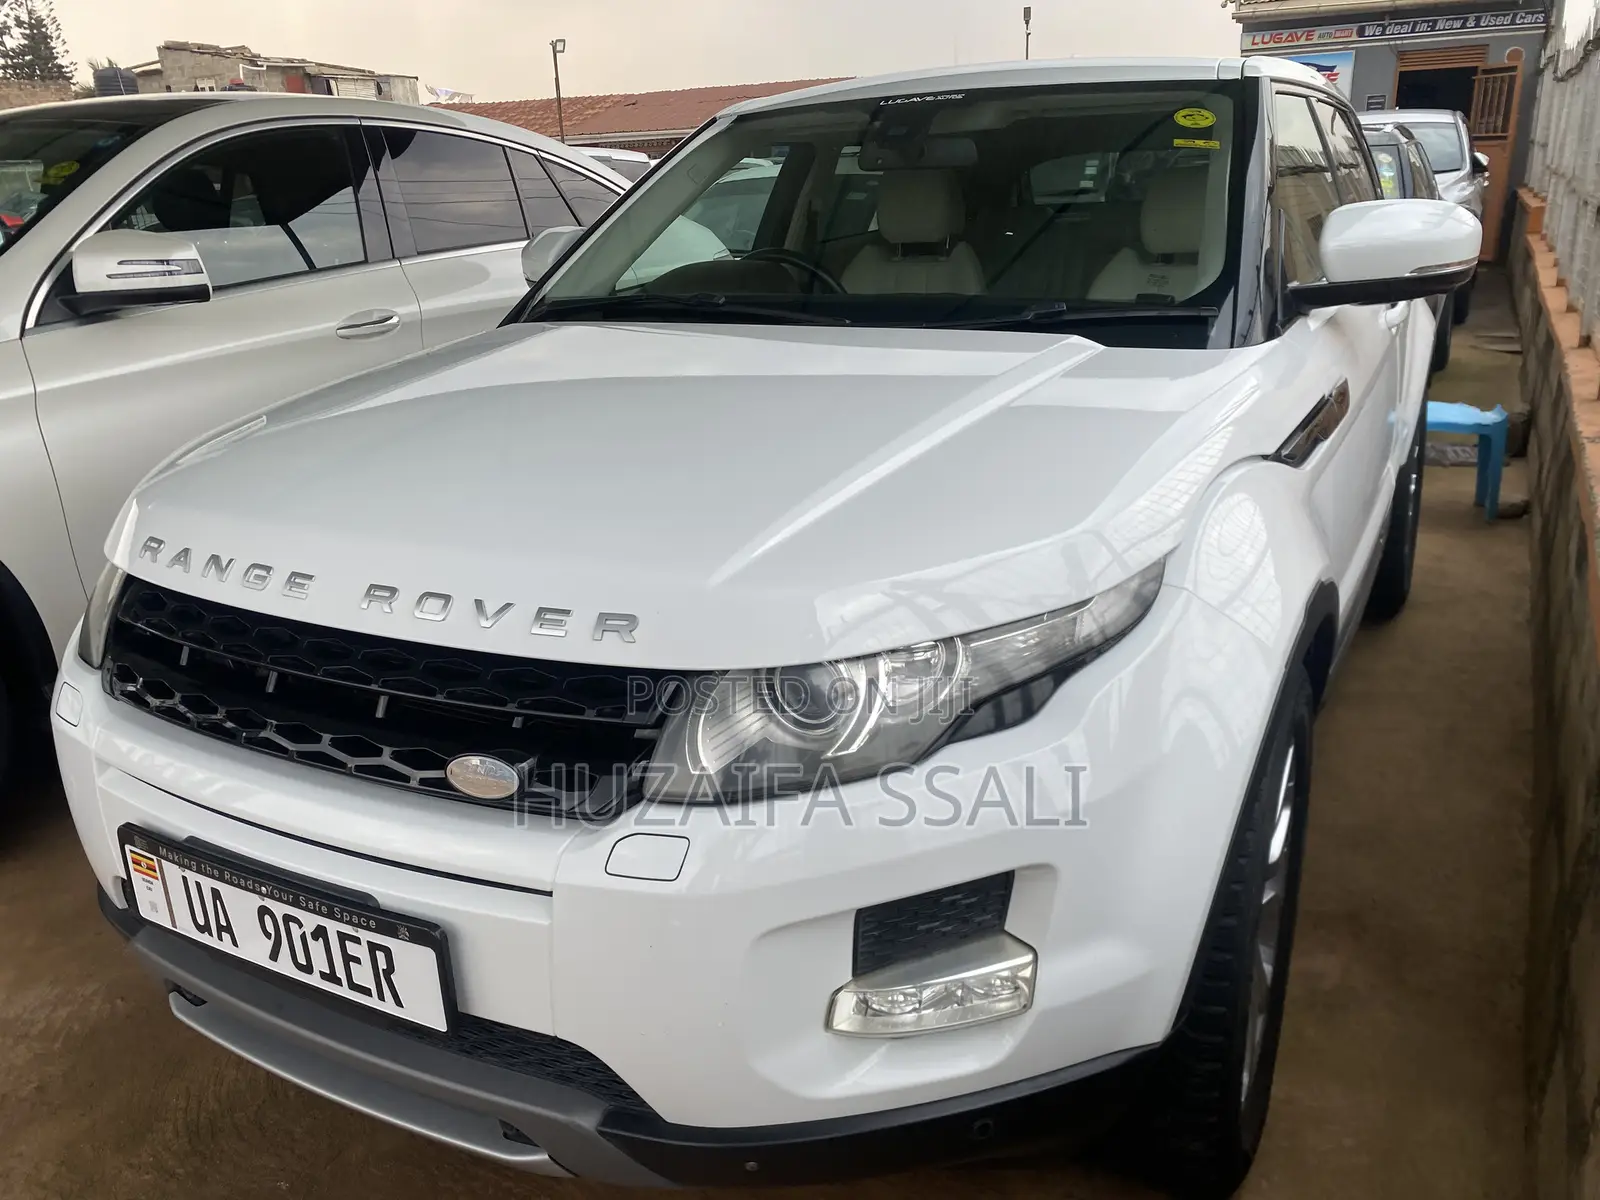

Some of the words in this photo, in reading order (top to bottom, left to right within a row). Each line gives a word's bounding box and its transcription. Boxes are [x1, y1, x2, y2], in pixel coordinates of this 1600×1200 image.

[1251, 29, 1316, 46] LUGAVE
[1317, 31, 1334, 39] AUTO
[1364, 24, 1383, 36] We
[1385, 22, 1413, 35] deal
[1415, 21, 1432, 32] in:
[1435, 18, 1463, 30] New
[1466, 15, 1476, 27] &
[1480, 13, 1512, 26] Used
[1515, 12, 1545, 24] Cars
[139, 536, 315, 600] RANGE
[360, 583, 640, 643] ROVER
[159, 846, 197, 871] Making
[201, 863, 219, 877] the
[224, 871, 260, 892] Roads
[266, 885, 293, 902] Your
[300, 896, 328, 914] Safe
[334, 907, 376, 928] Space
[181, 875, 239, 948] UA
[257, 905, 405, 1008] 901ER
